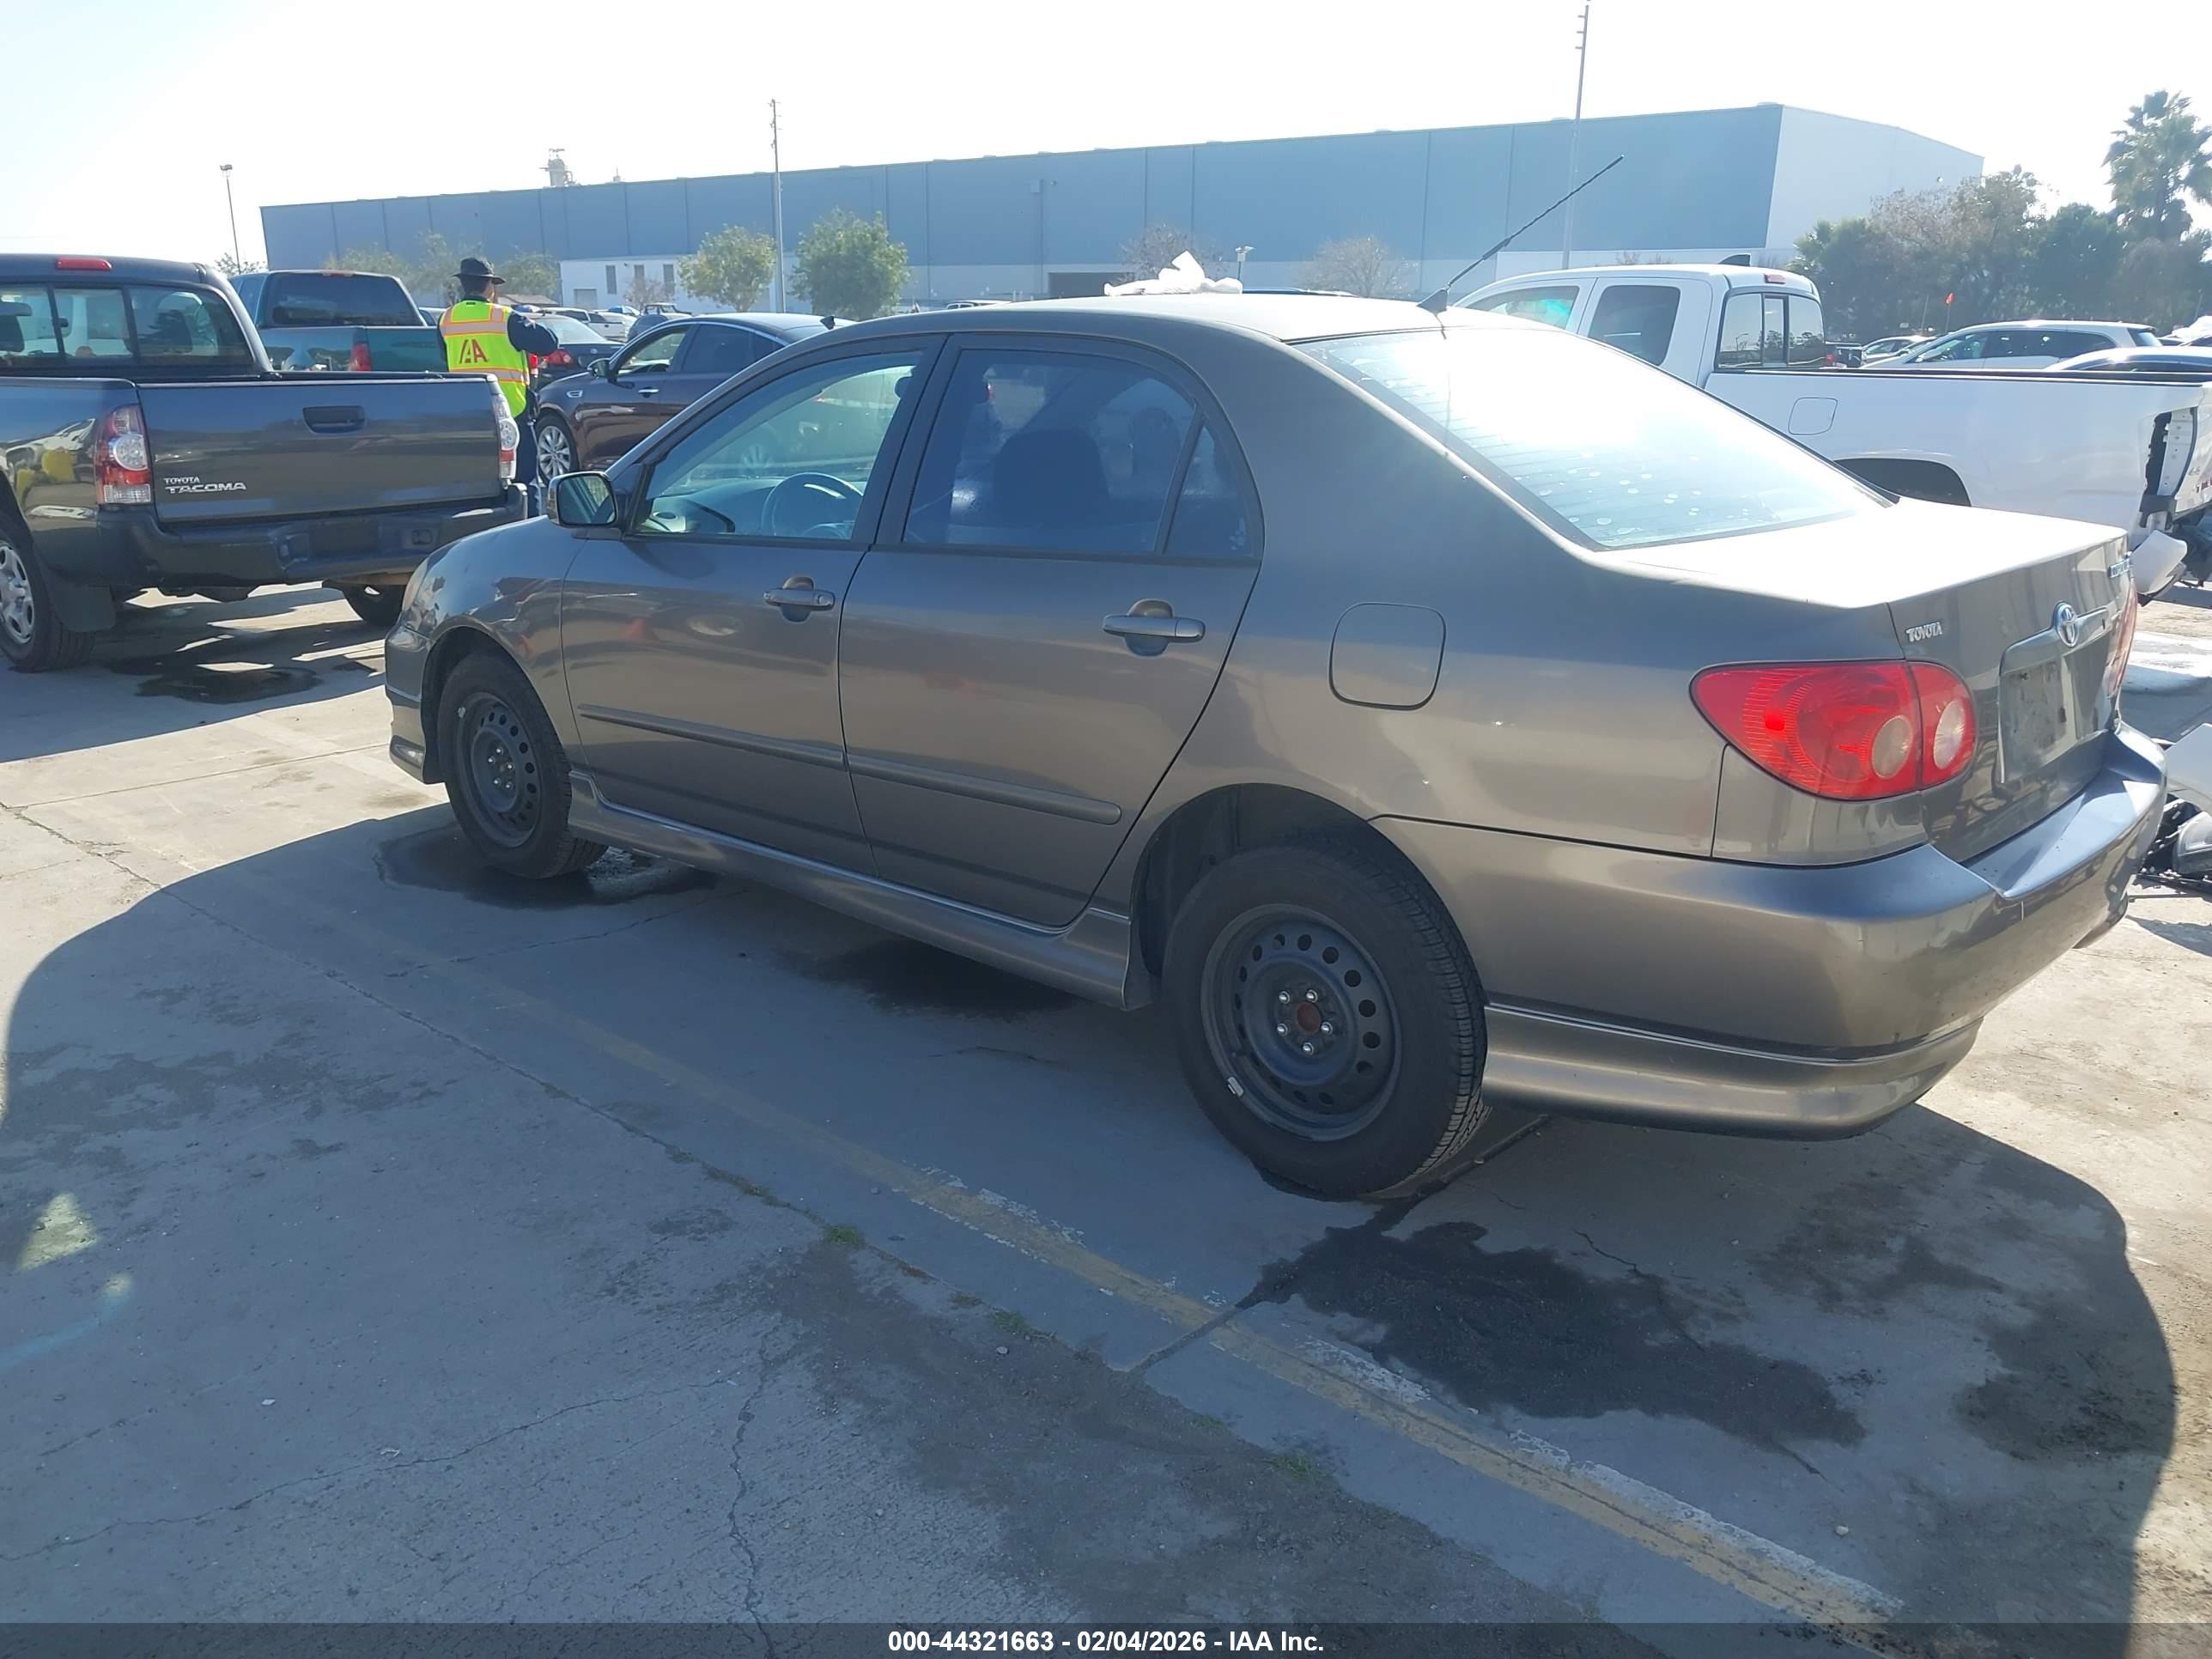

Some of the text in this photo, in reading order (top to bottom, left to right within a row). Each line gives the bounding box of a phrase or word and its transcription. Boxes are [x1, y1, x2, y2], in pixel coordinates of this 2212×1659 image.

[163, 476, 200, 484] TOYOTA
[165, 482, 246, 495] TACOMA
[1905, 621, 1943, 642] TOYOTA
